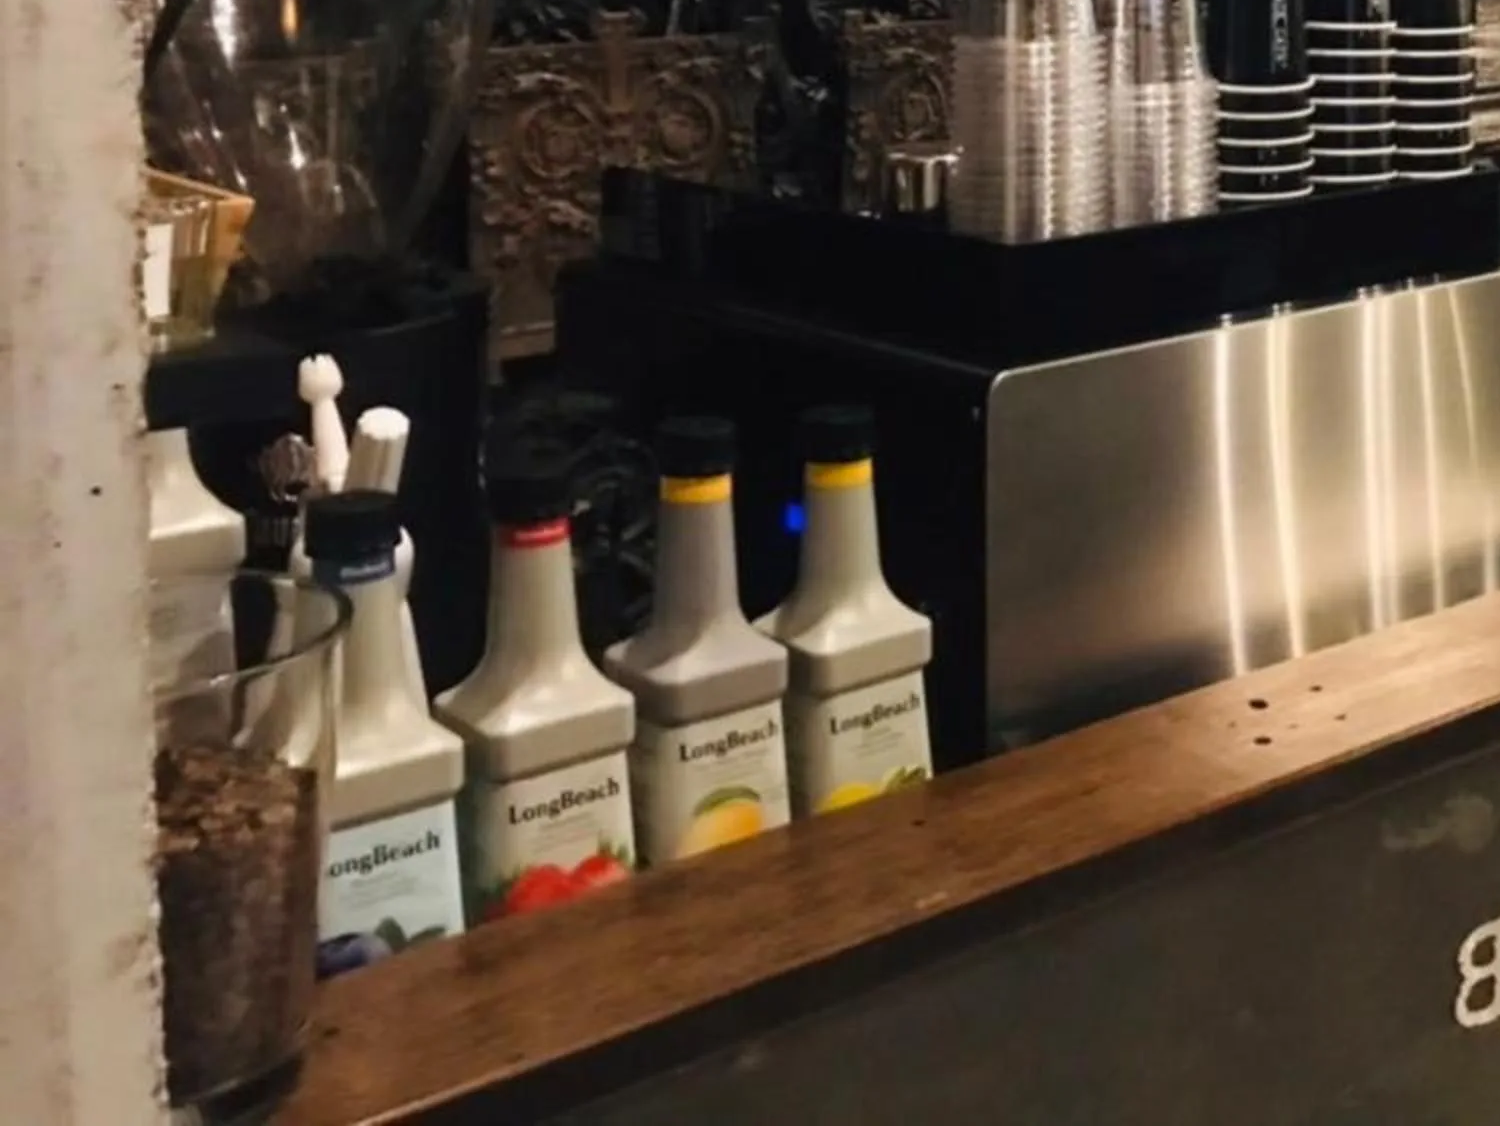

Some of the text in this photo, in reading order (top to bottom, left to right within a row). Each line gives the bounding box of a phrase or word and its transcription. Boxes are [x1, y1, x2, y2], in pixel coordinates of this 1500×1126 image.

[829, 693, 921, 735] LongBeach
[678, 718, 779, 763] LongBeach
[508, 777, 620, 825] LongBeach
[328, 830, 440, 878] ongBeach
